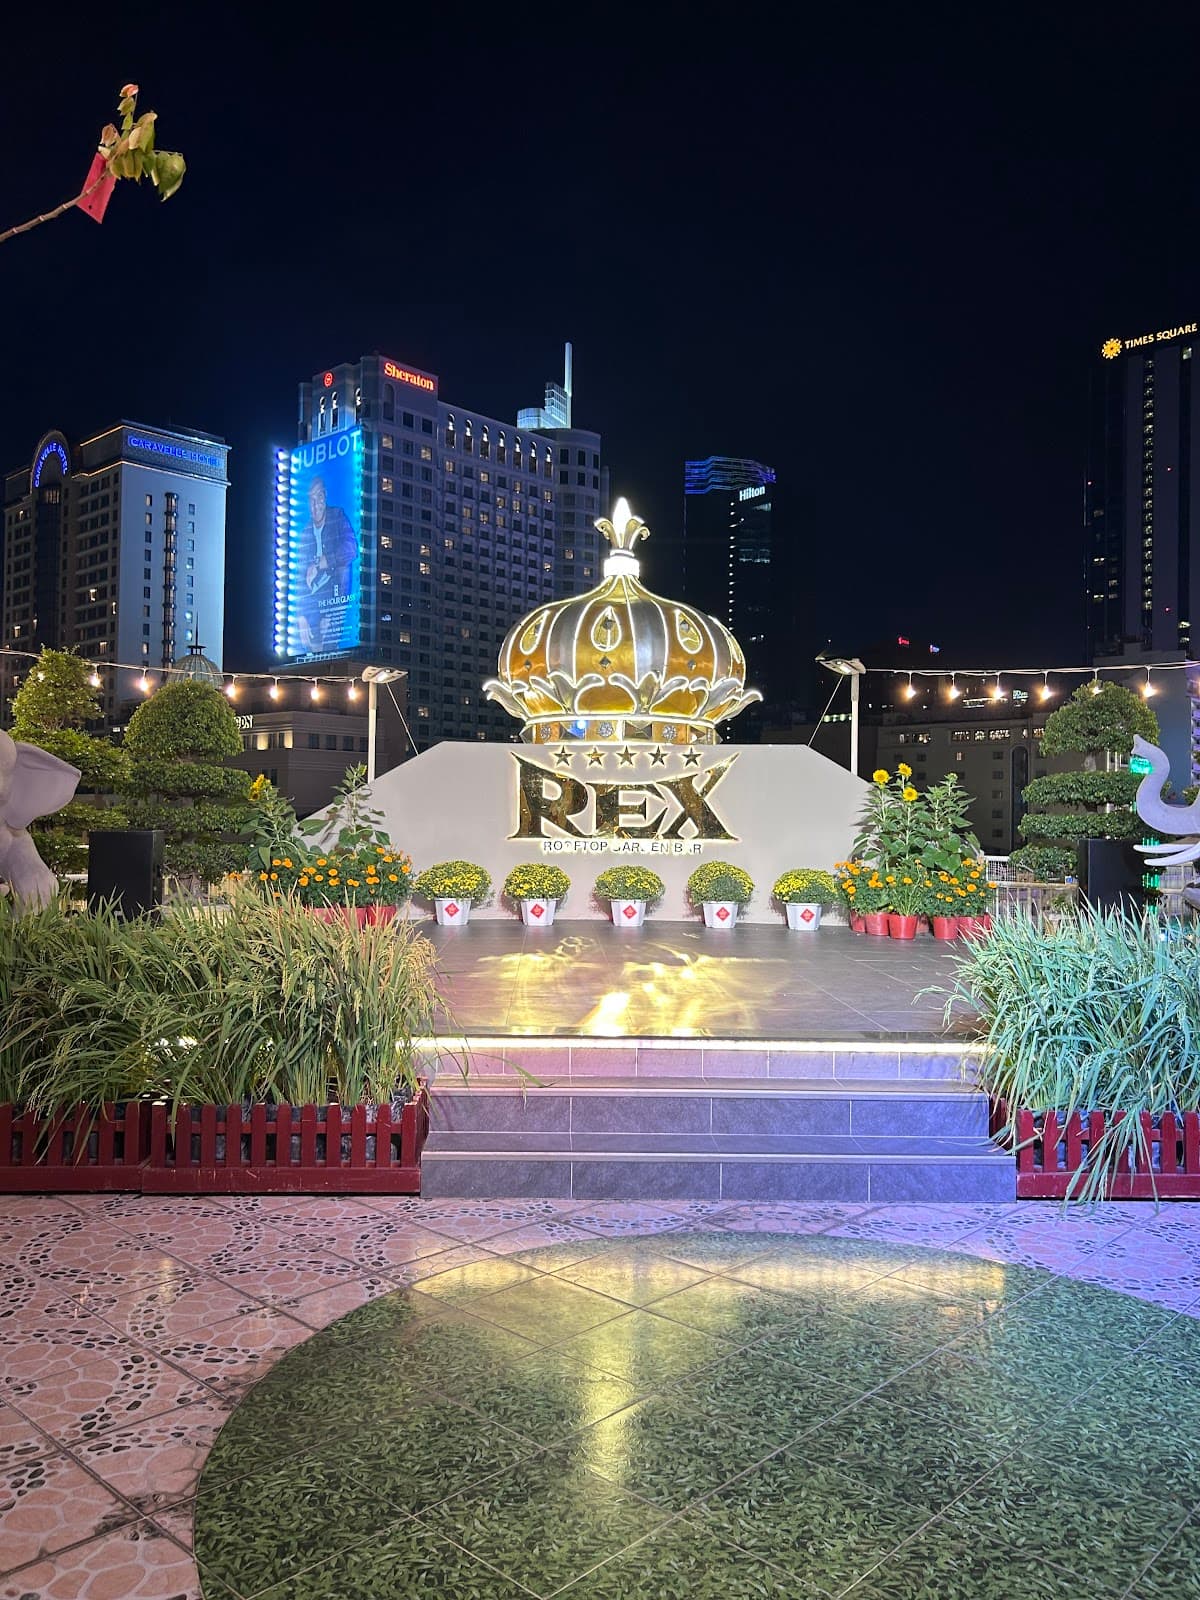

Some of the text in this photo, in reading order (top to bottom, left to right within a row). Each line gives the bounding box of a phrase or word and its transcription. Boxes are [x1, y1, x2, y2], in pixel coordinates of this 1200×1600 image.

[1124, 323, 1198, 350] TIMES SQUARE
[383, 361, 434, 391] Sheraton
[128, 436, 220, 467] CARAVELLE HOTEL
[291, 430, 362, 472] HUBLOT
[739, 485, 766, 501] Hilton
[507, 751, 740, 840] REX
[612, 841, 669, 853] AREN
[674, 842, 702, 854] BR
